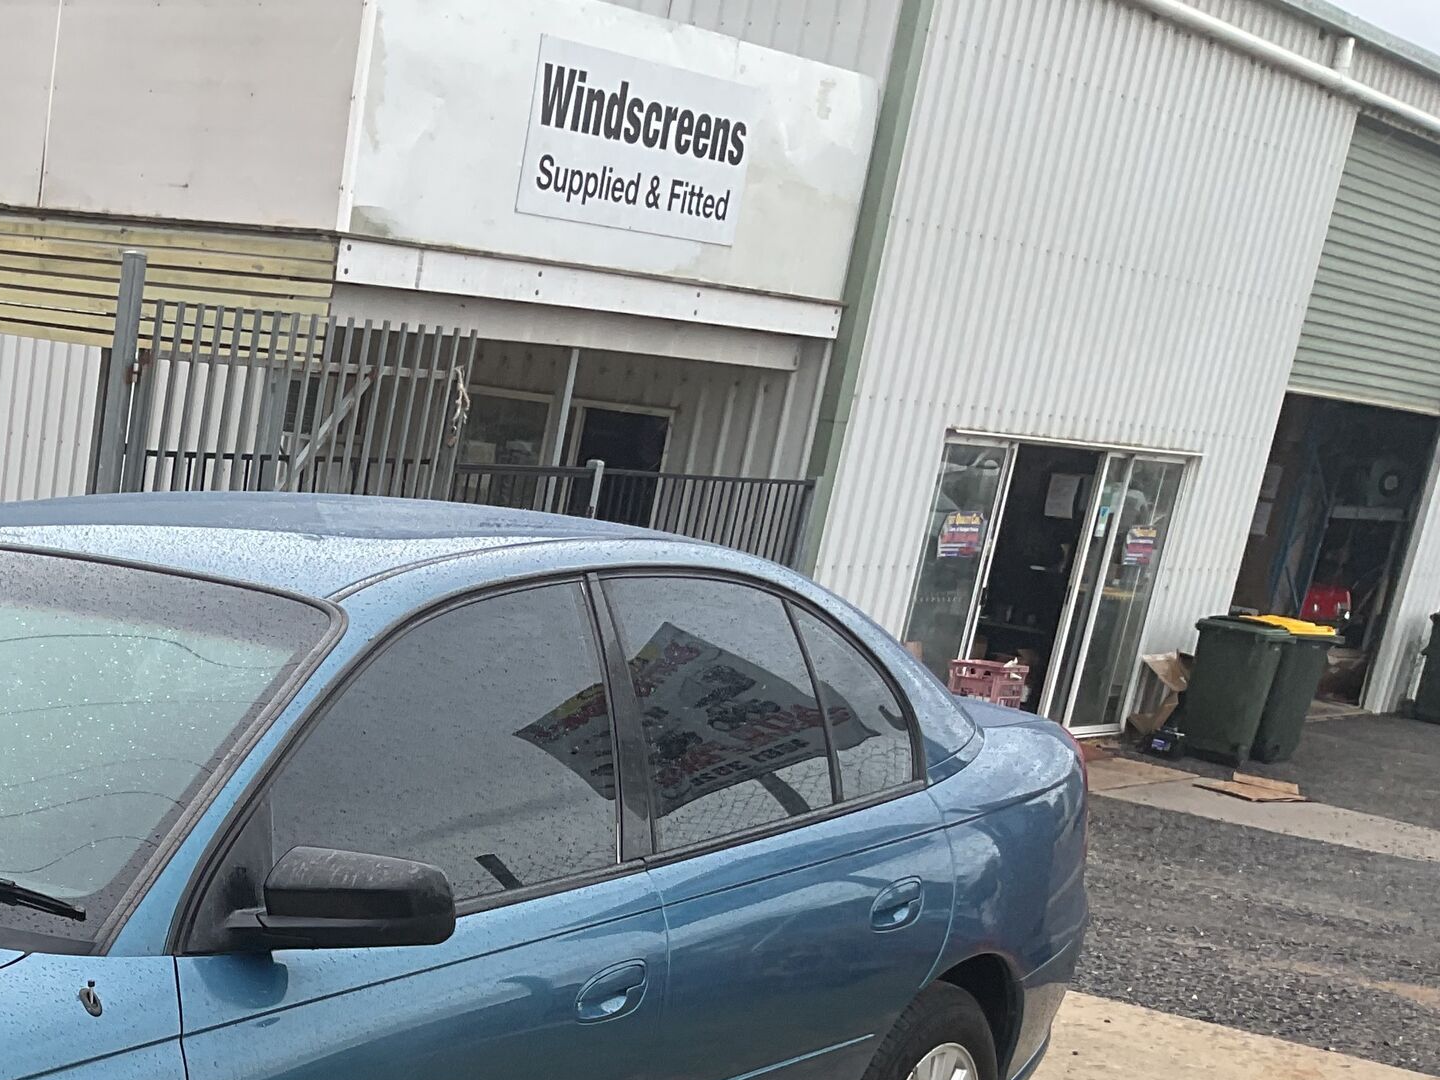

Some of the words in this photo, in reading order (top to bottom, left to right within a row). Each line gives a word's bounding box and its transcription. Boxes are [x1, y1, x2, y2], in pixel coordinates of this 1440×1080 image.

[541, 62, 747, 165] Windscreens
[536, 154, 641, 205] Supplied
[645, 175, 660, 210] &
[667, 178, 731, 221] Fitted
